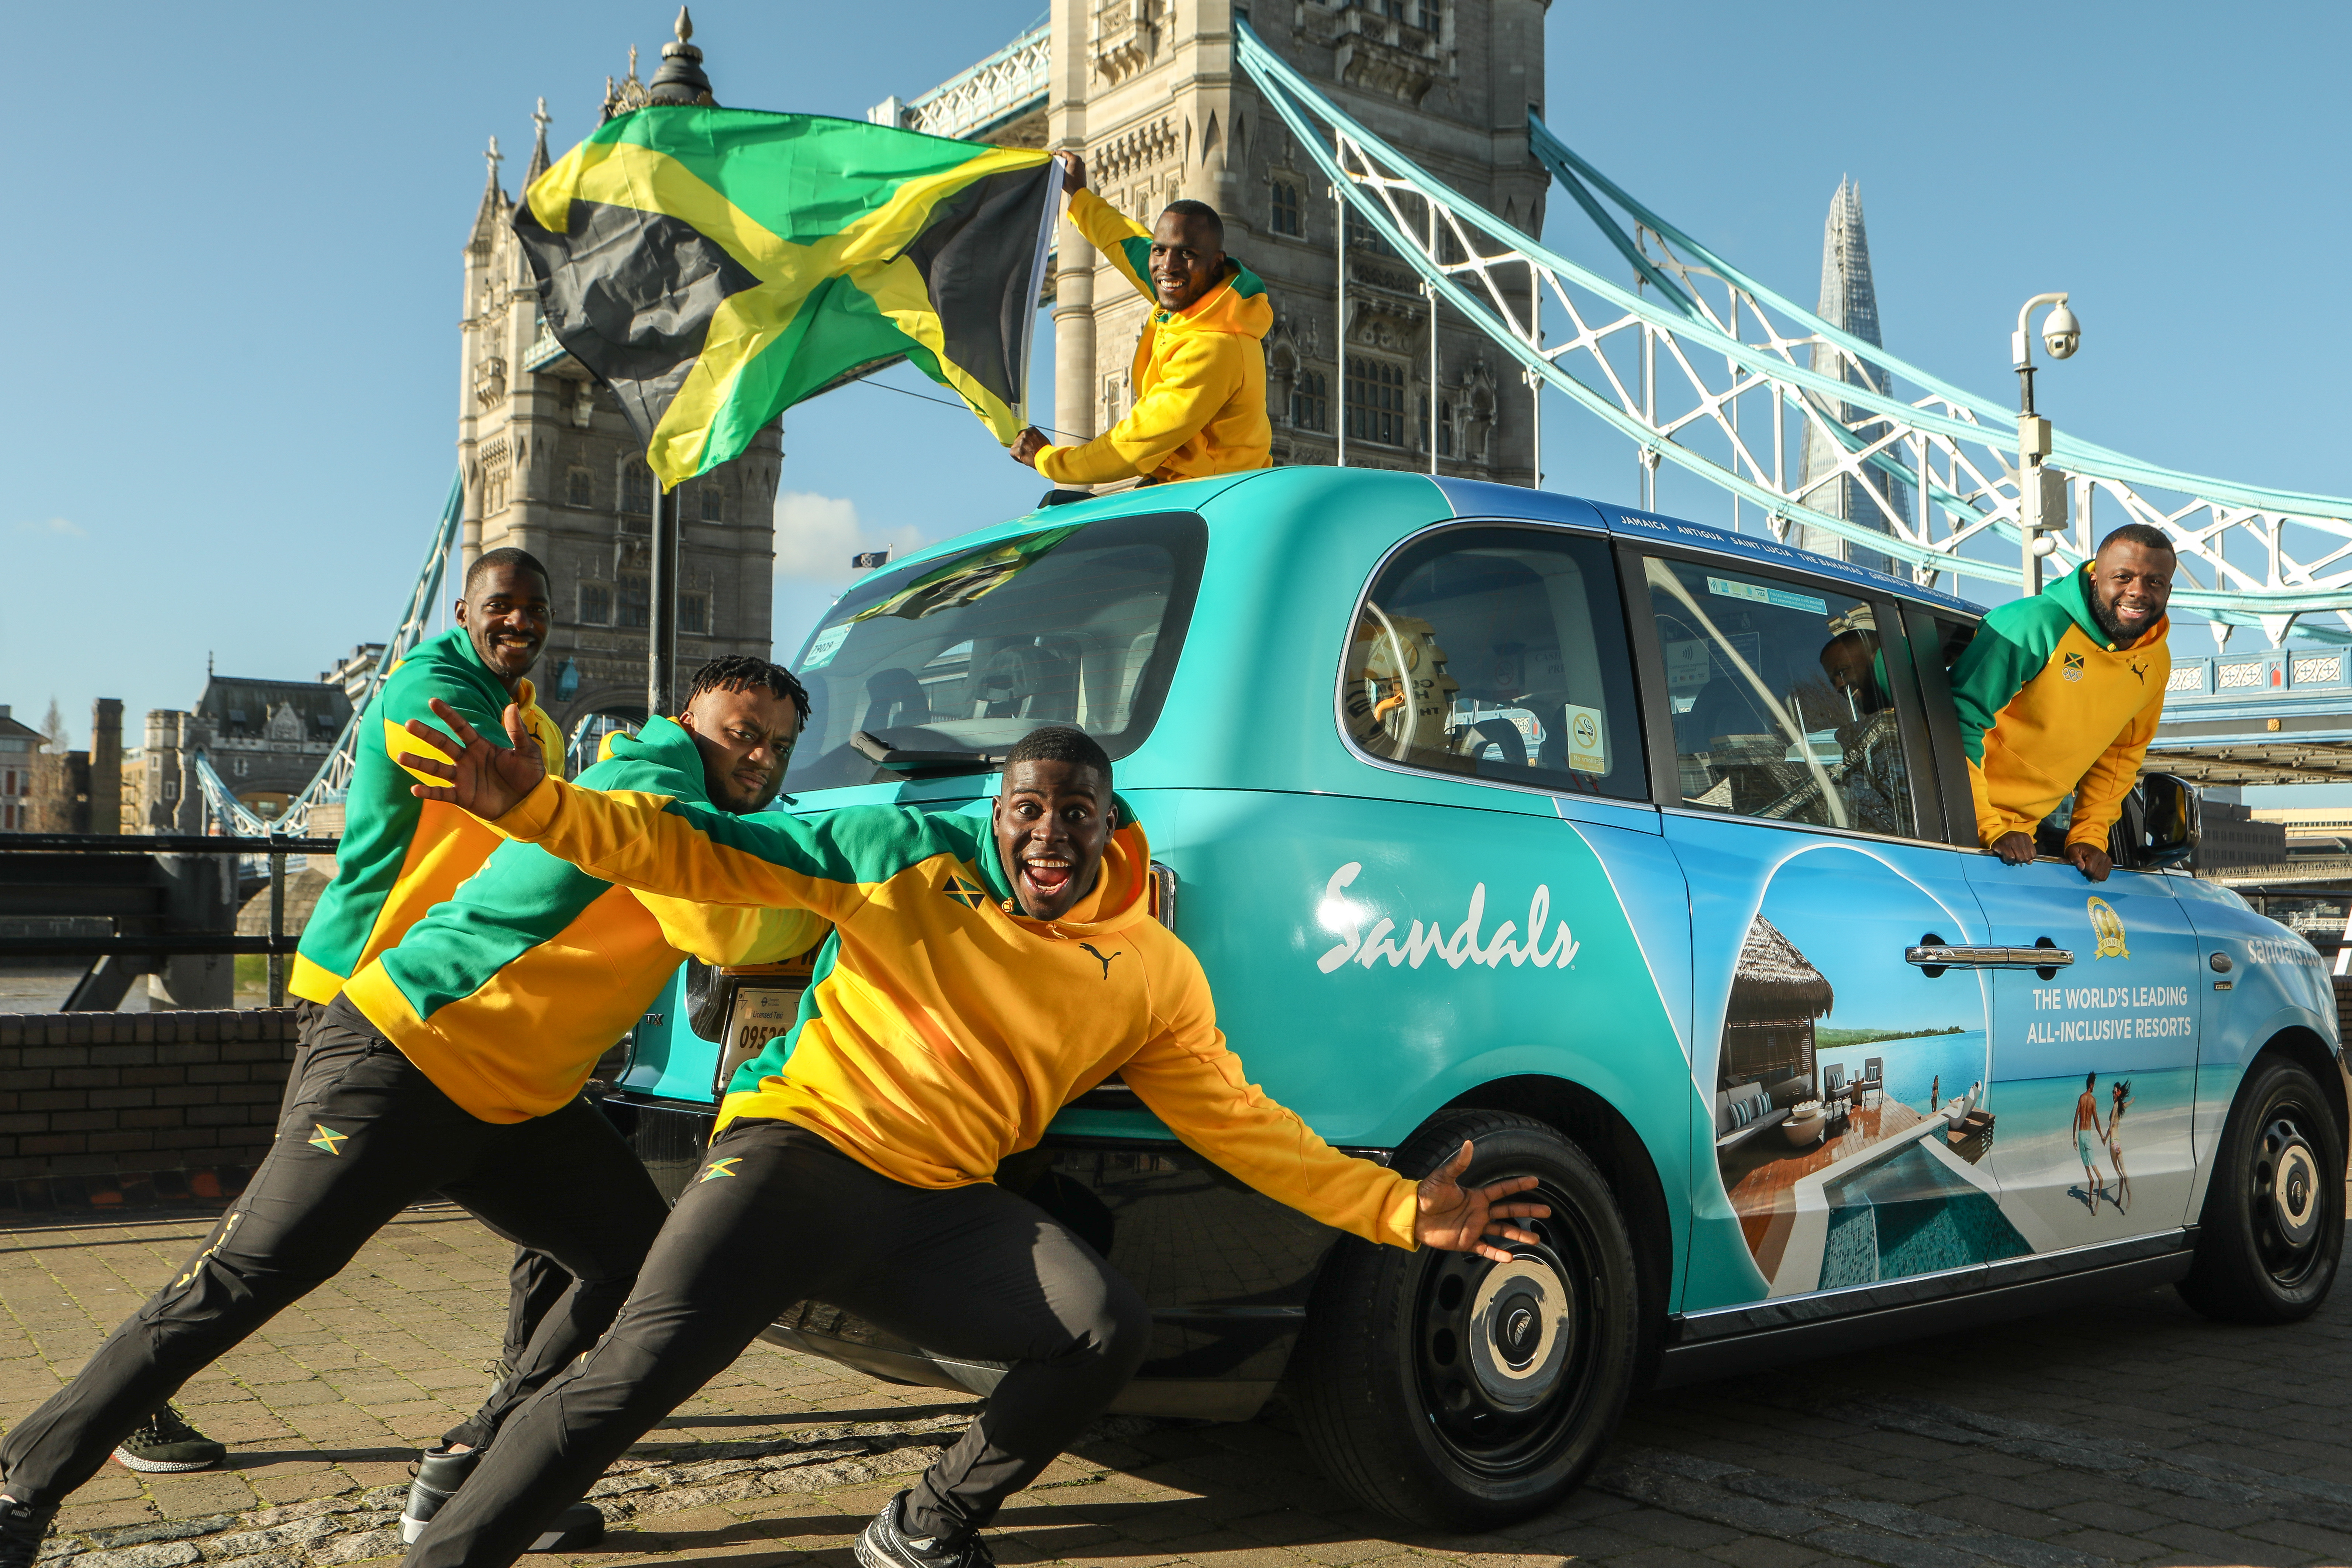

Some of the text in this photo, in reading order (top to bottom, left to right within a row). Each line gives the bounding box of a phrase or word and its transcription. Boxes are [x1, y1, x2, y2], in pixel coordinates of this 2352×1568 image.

[1621, 515, 1670, 532] JAMAICA
[1677, 525, 1725, 542] ANTIGUA
[1730, 537, 1761, 551] SAINT
[1761, 544, 1793, 558] LUCIA
[1797, 552, 1818, 565] THE
[1820, 558, 1864, 576] BAHAMAS
[1868, 572, 1911, 589] GRENADA
[1915, 585, 1961, 604] BARBADOS
[1791, 600, 1806, 608] including
[1806, 603, 1822, 611] contactless
[1582, 757, 1600, 766] smoking
[1317, 861, 1580, 974] Sandals
[2089, 898, 2124, 939] WORLD TRAVEL AWARDS
[2100, 938, 2122, 948] WINNER
[2247, 935, 2324, 968] sandals.co
[2033, 986, 2187, 1010] THE WORLD'S LEADING
[644, 1013, 665, 1027] TX
[752, 1010, 783, 1019] Licensed Taxi
[2026, 1016, 2191, 1045] ALL-INCLUSIVE RESORTS
[11, 1509, 28, 1518] PUMA
